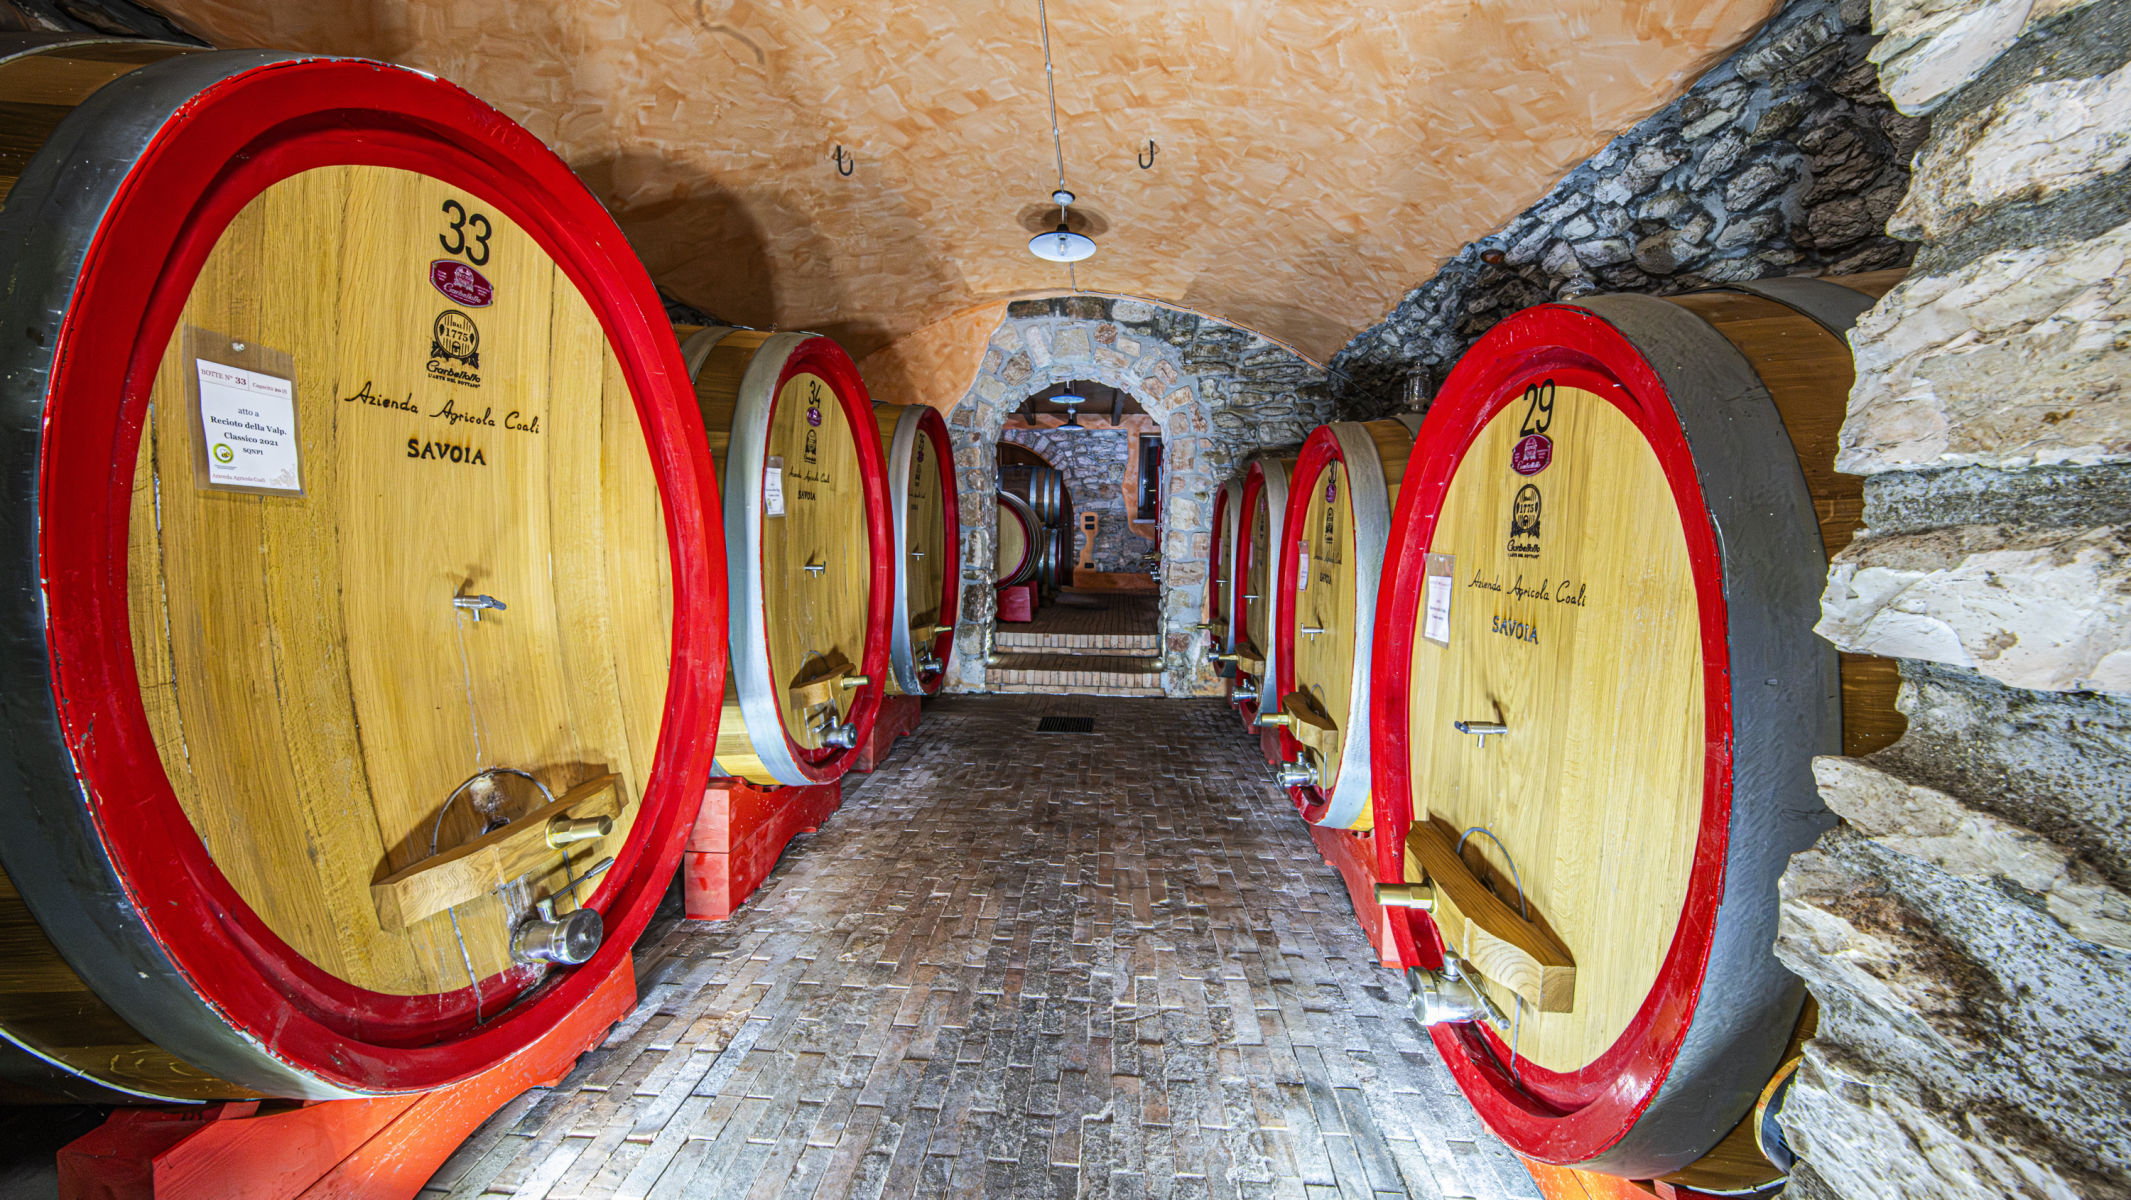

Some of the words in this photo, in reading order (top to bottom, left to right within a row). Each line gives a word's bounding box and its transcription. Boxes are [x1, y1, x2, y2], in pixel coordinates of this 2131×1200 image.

[439, 199, 492, 266] 33
[446, 328, 469, 342] 1775
[201, 368, 223, 379] BOTTE
[235, 376, 247, 385] 33
[344, 381, 419, 414] Azienda
[429, 400, 496, 425] Agricola
[504, 411, 540, 434] Coali
[808, 380, 821, 408] 34
[1519, 378, 1555, 437] 29
[237, 408, 253, 416] atto
[210, 416, 243, 428] Recioto
[244, 421, 265, 431] della
[266, 425, 287, 436] Valp.
[223, 431, 258, 443] Classico
[259, 438, 279, 446] 2021
[407, 438, 486, 465] SAVOIA
[1519, 503, 1534, 514] 1775
[1468, 569, 1501, 592] Azienda
[1507, 574, 1549, 601] Agricola
[1556, 580, 1586, 607] Coali
[1492, 615, 1539, 645] SAVOIA
